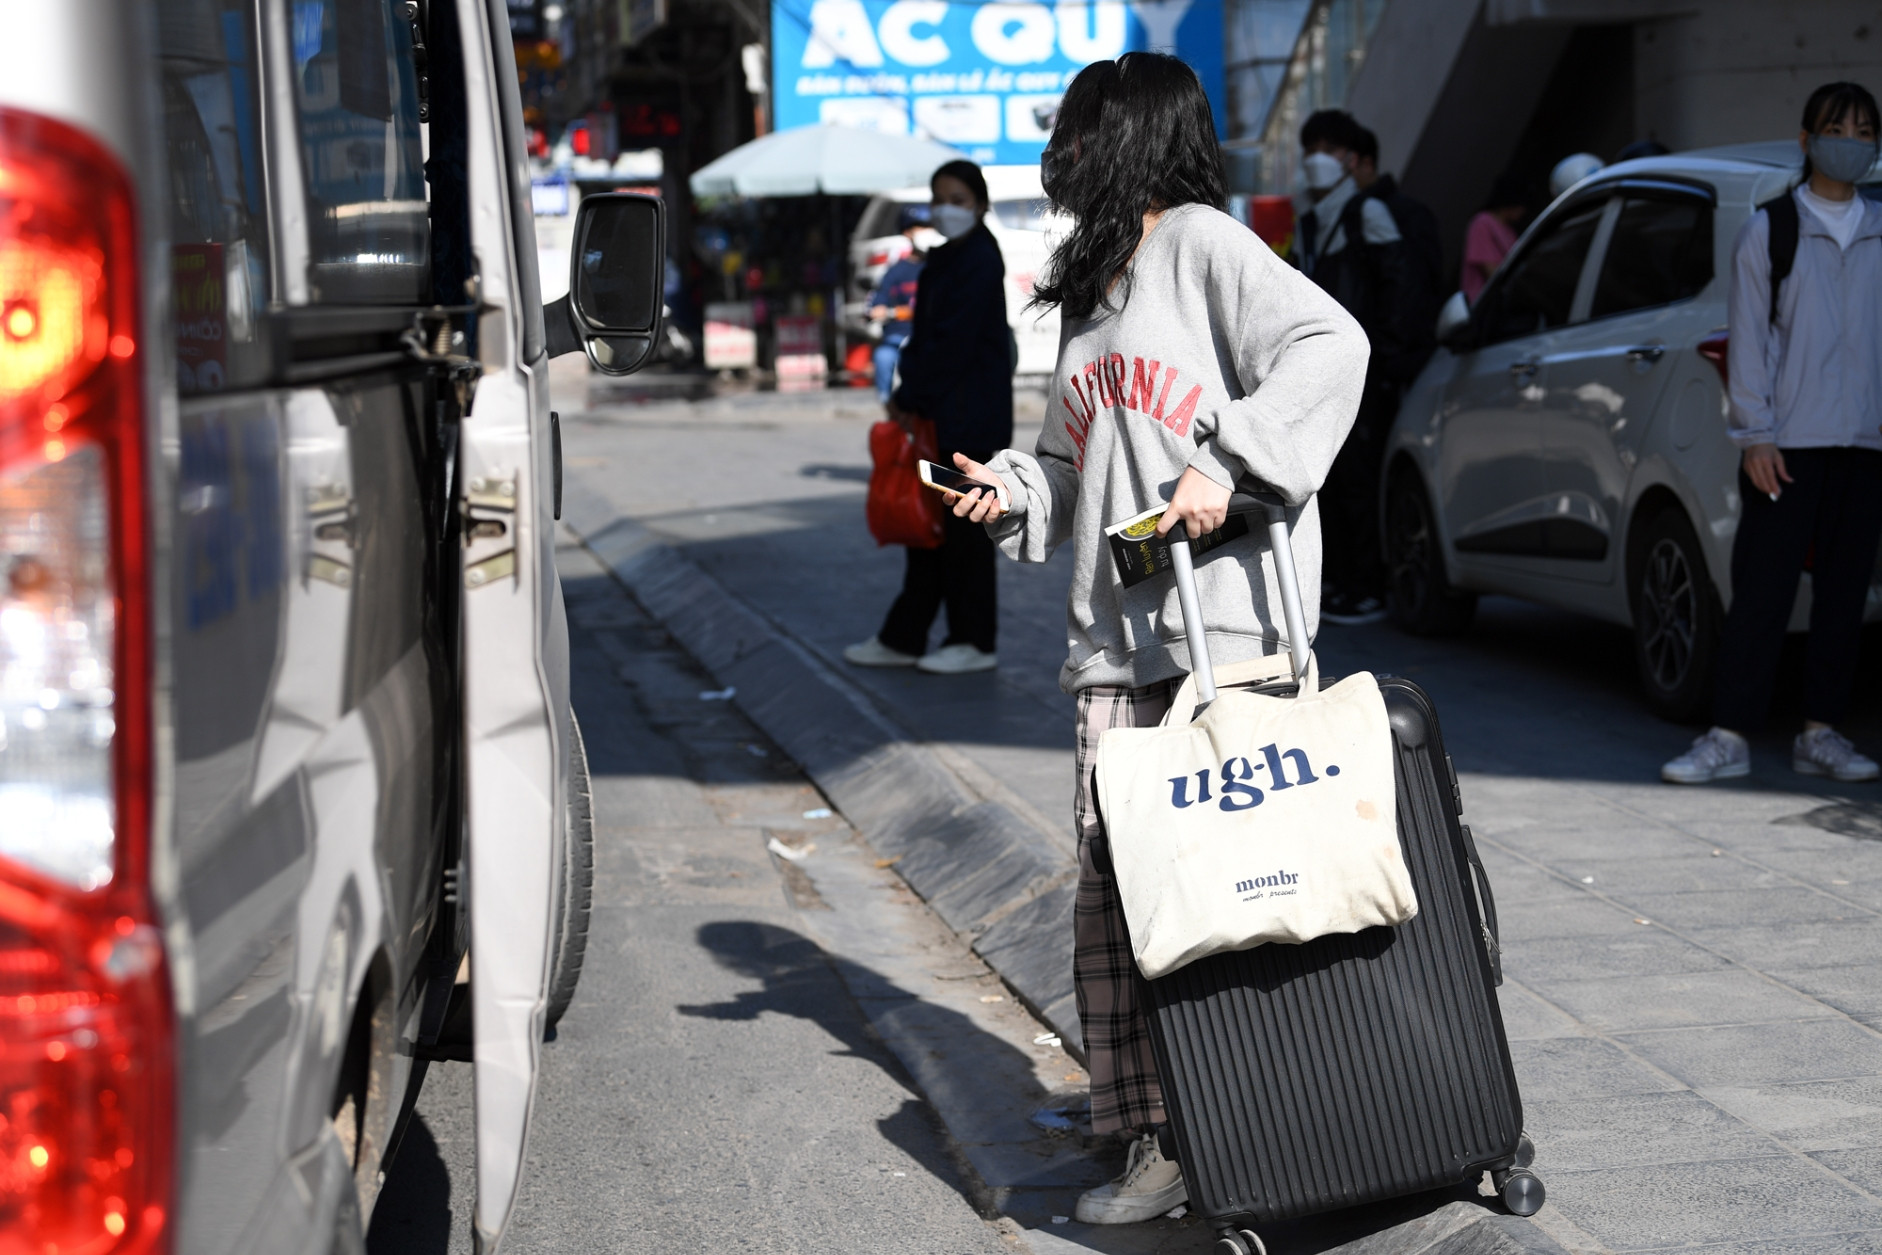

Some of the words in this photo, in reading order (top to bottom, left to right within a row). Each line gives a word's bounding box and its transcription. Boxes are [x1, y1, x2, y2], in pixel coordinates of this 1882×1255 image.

[970, 0, 1192, 66] QUY
[1167, 742, 1340, 812] ugh.
[1235, 869, 1299, 893] monbr
